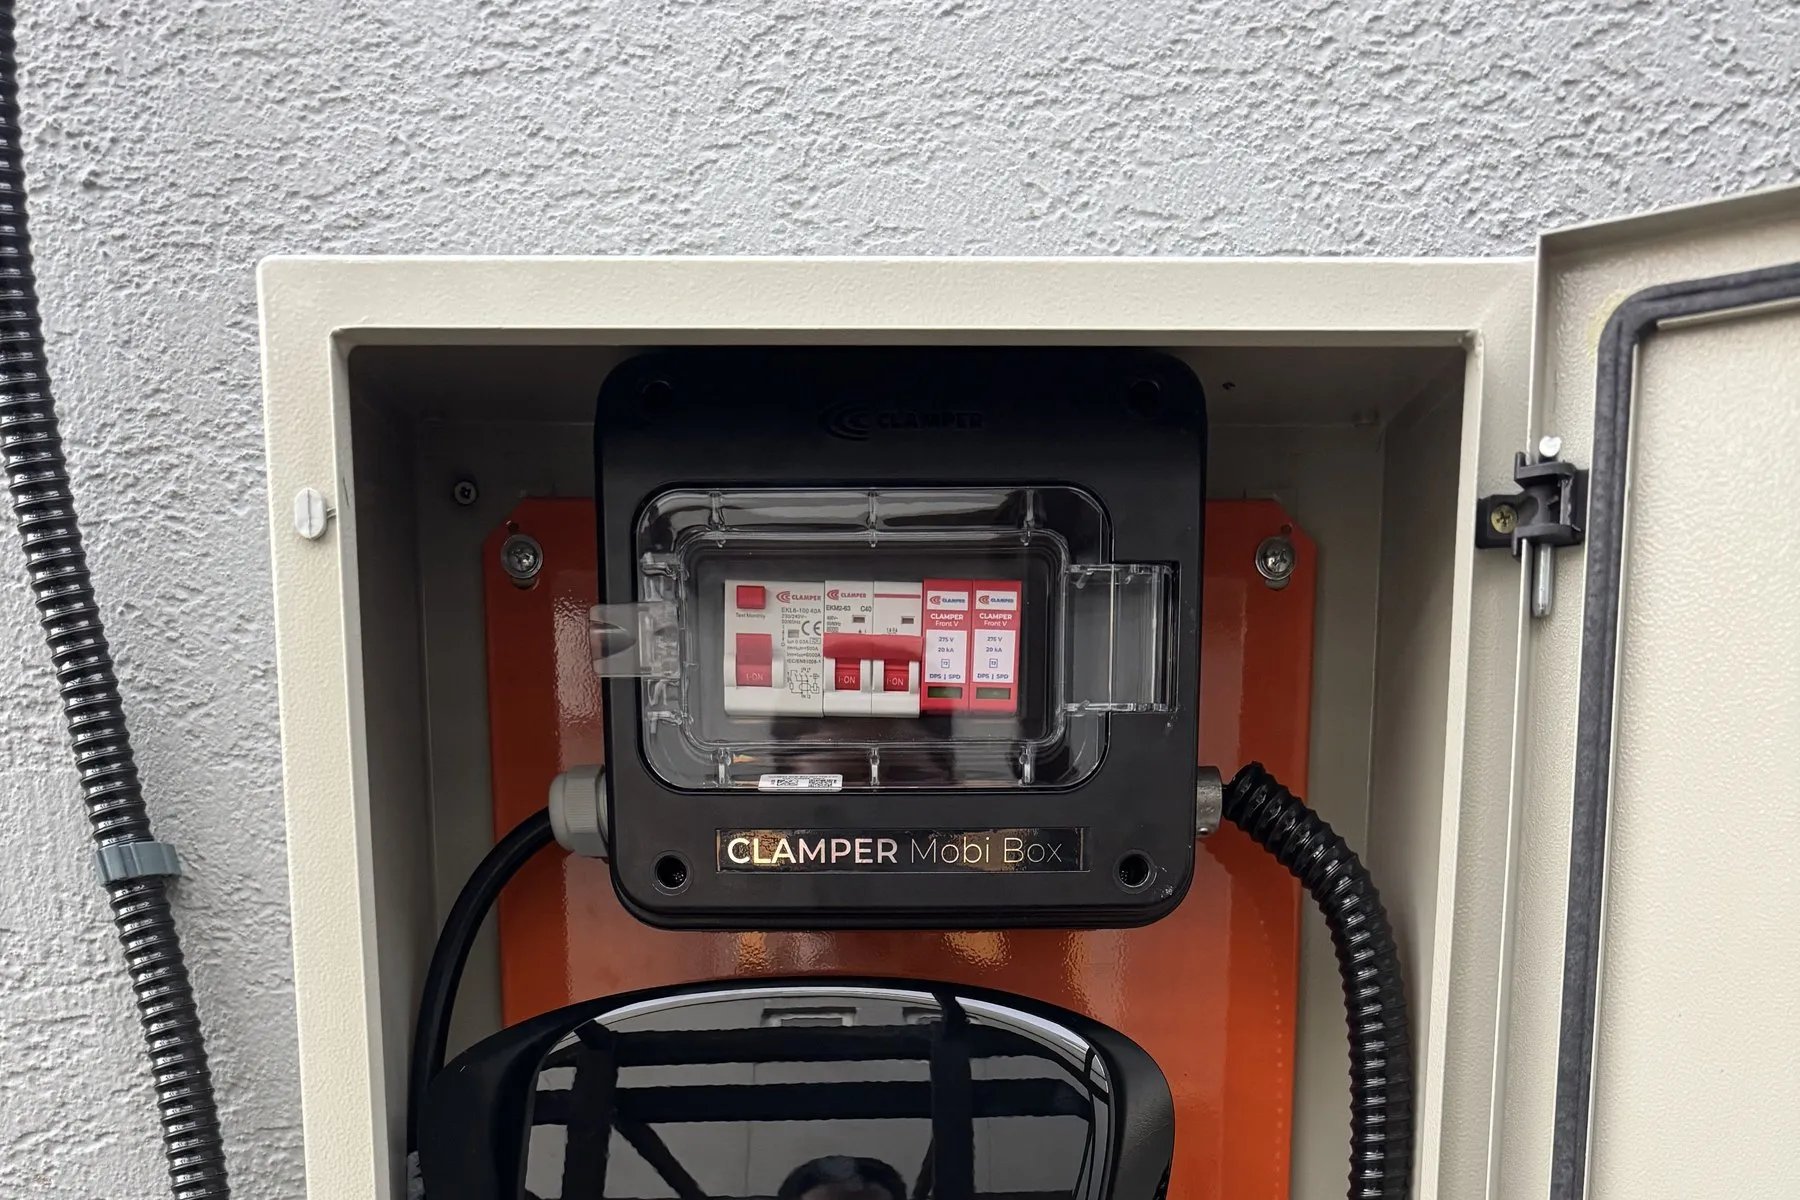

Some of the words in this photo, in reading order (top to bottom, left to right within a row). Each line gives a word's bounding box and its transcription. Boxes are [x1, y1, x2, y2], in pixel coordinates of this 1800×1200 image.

[876, 410, 984, 431] CLAMPER
[791, 594, 822, 602] CLAMPER
[930, 613, 964, 621] CLAMPER
[979, 612, 1013, 620] CLAMPER
[727, 837, 898, 864] CLAMPER
[910, 836, 991, 864] Mobi
[1003, 837, 1063, 864] Box
